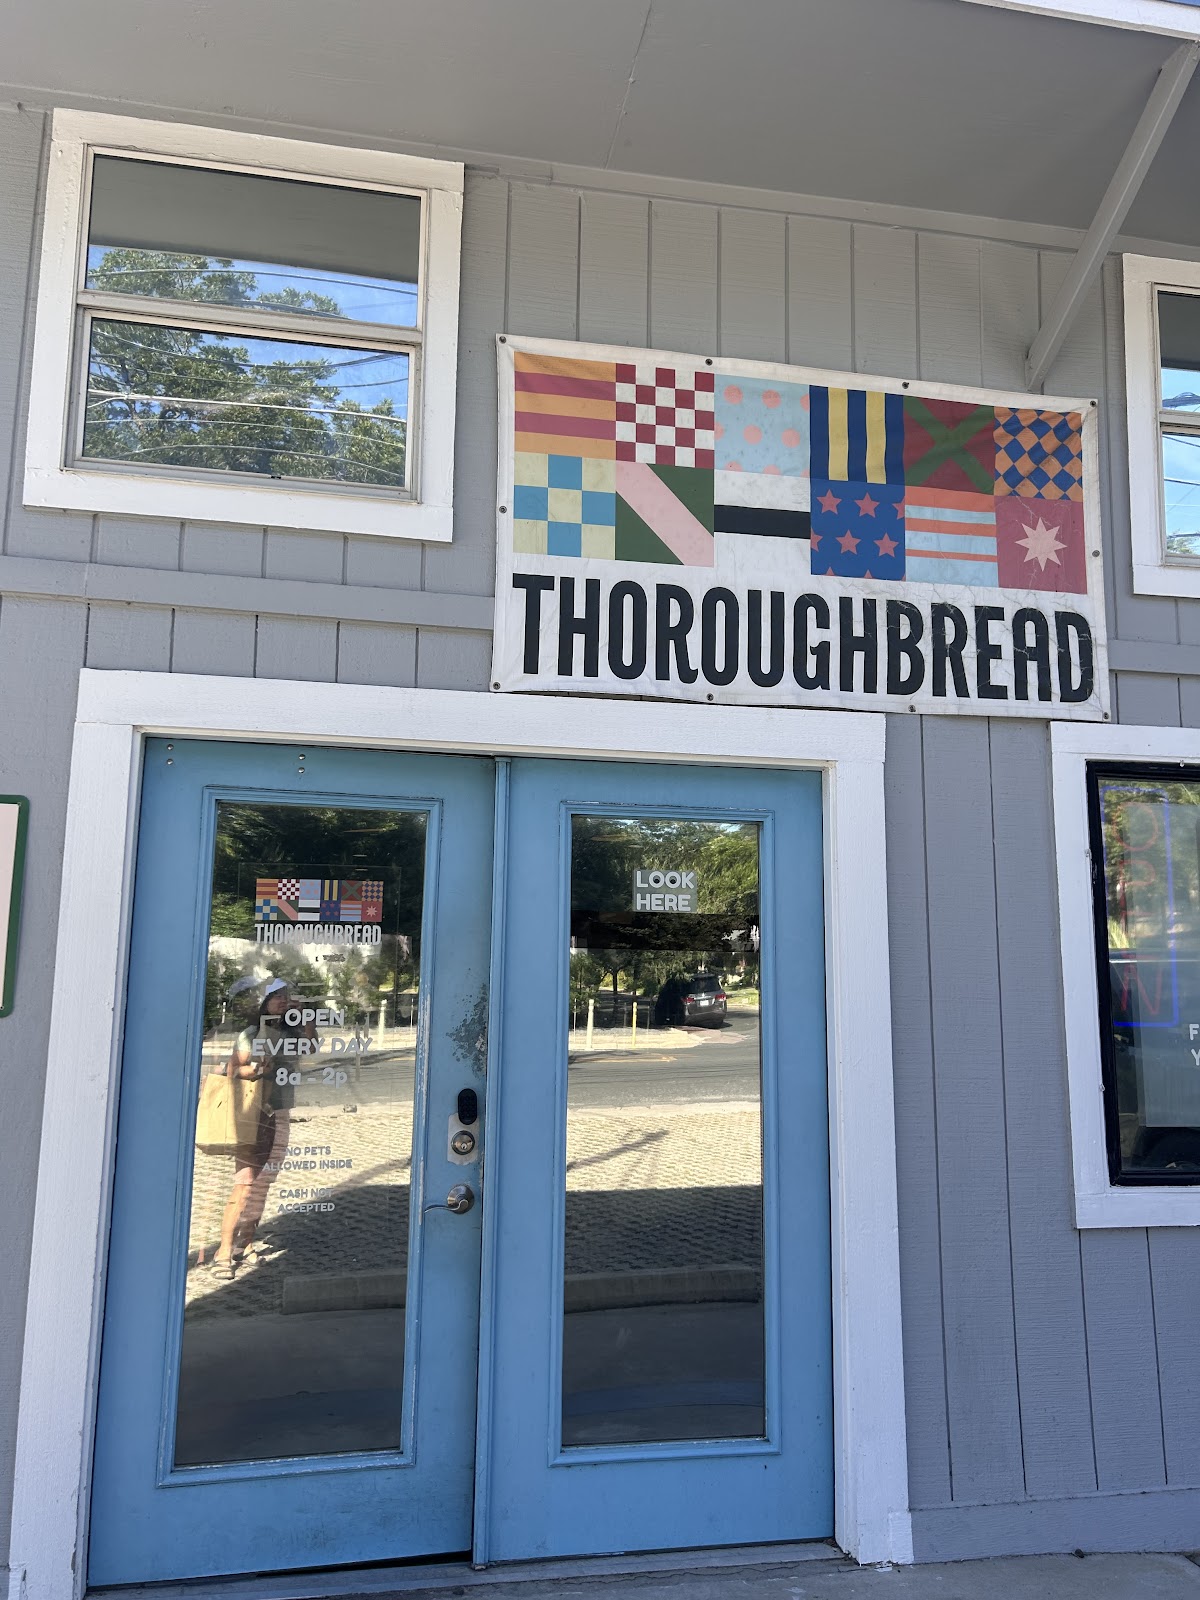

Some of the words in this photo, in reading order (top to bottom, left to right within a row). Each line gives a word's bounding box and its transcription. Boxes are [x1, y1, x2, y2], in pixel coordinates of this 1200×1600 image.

[512, 573, 1093, 703] THOROUGHBREAD
[636, 871, 695, 889] LOOK
[636, 893, 691, 912] HERE
[255, 923, 382, 946] THOROUGHBREAD
[284, 1008, 345, 1027] OPEN
[252, 1037, 325, 1056] EVERY
[331, 1037, 373, 1055] DAY
[275, 1067, 302, 1086] 8a
[322, 1067, 348, 1088] 2p
[286, 1147, 301, 1156] NO
[304, 1146, 331, 1156] PETS
[262, 1160, 317, 1171] ALLOWED
[319, 1159, 353, 1169] INSIDE
[280, 1189, 308, 1199] CASH
[310, 1188, 334, 1198] NOT
[277, 1203, 336, 1213] ACCEPTED
